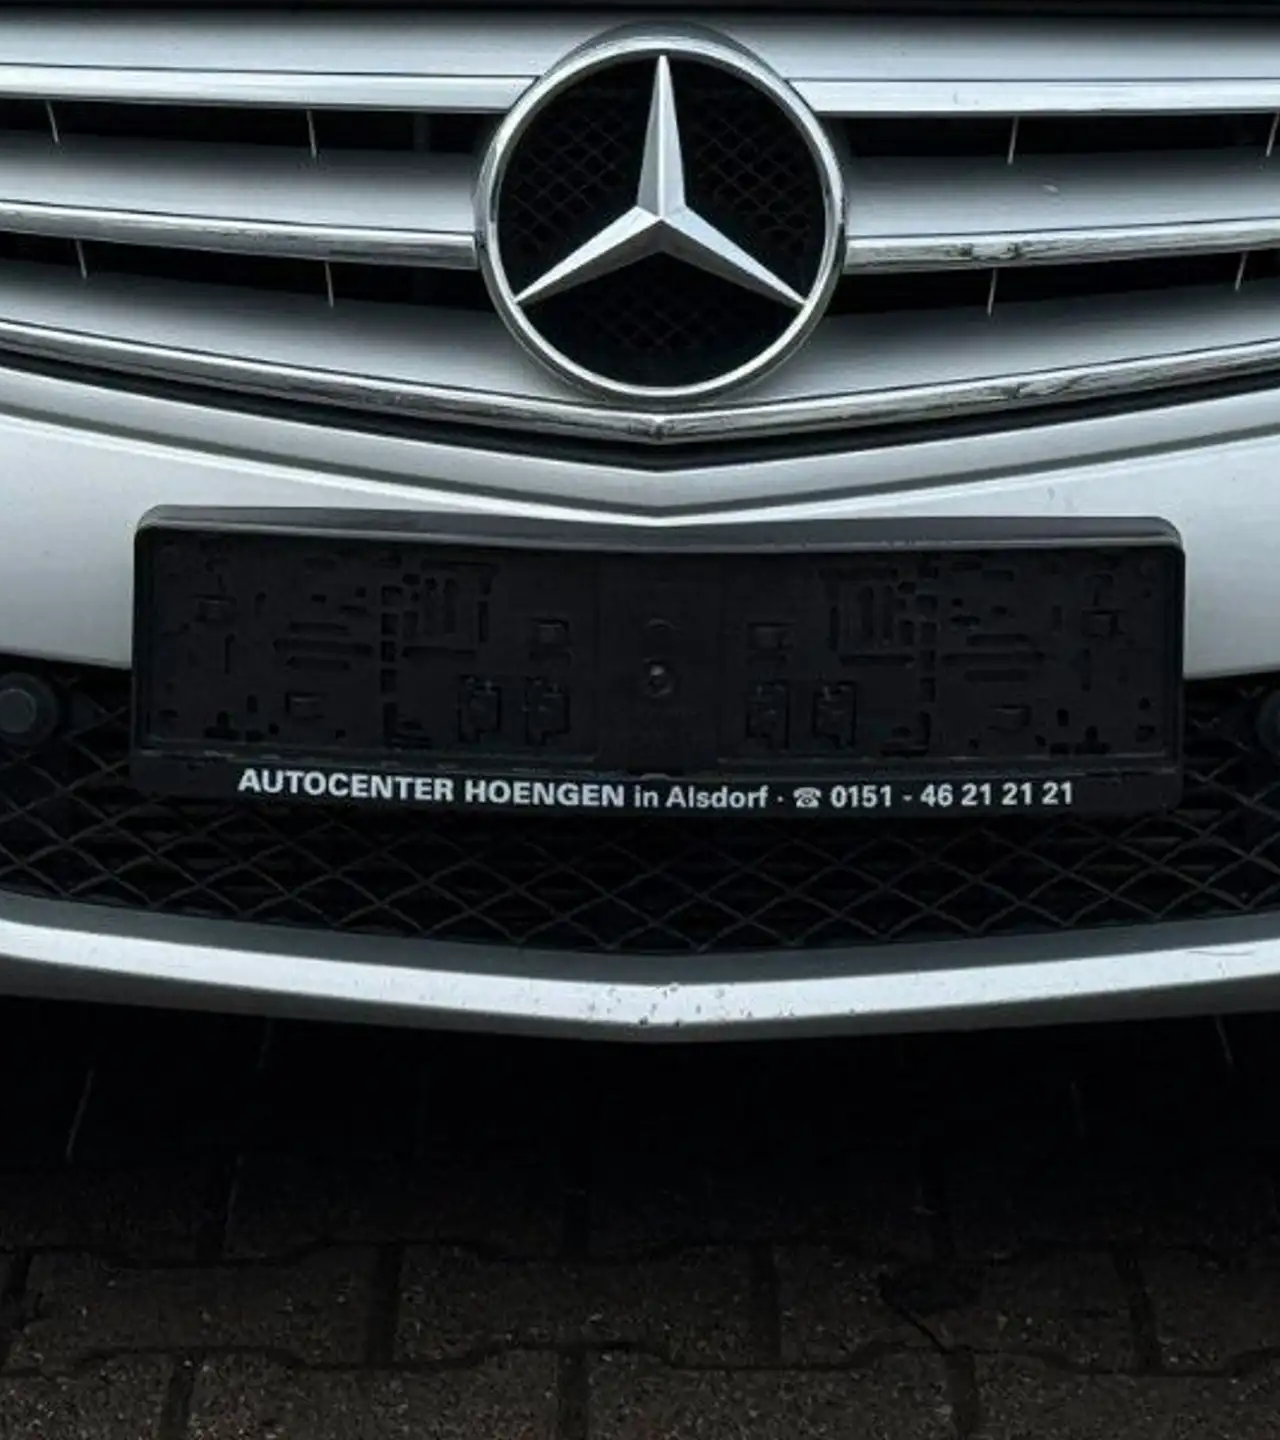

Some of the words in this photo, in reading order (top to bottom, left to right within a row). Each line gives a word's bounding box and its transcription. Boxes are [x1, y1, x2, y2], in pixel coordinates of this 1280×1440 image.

[237, 767, 455, 802] AUTOCENTER
[464, 779, 626, 807] HOENGEN
[633, 785, 659, 808] in
[665, 785, 770, 809] Alsdorf
[829, 784, 893, 808] 0151
[920, 783, 955, 808] 46
[961, 782, 992, 807] 21
[1001, 782, 1033, 806] 21
[1042, 781, 1073, 806] 21
